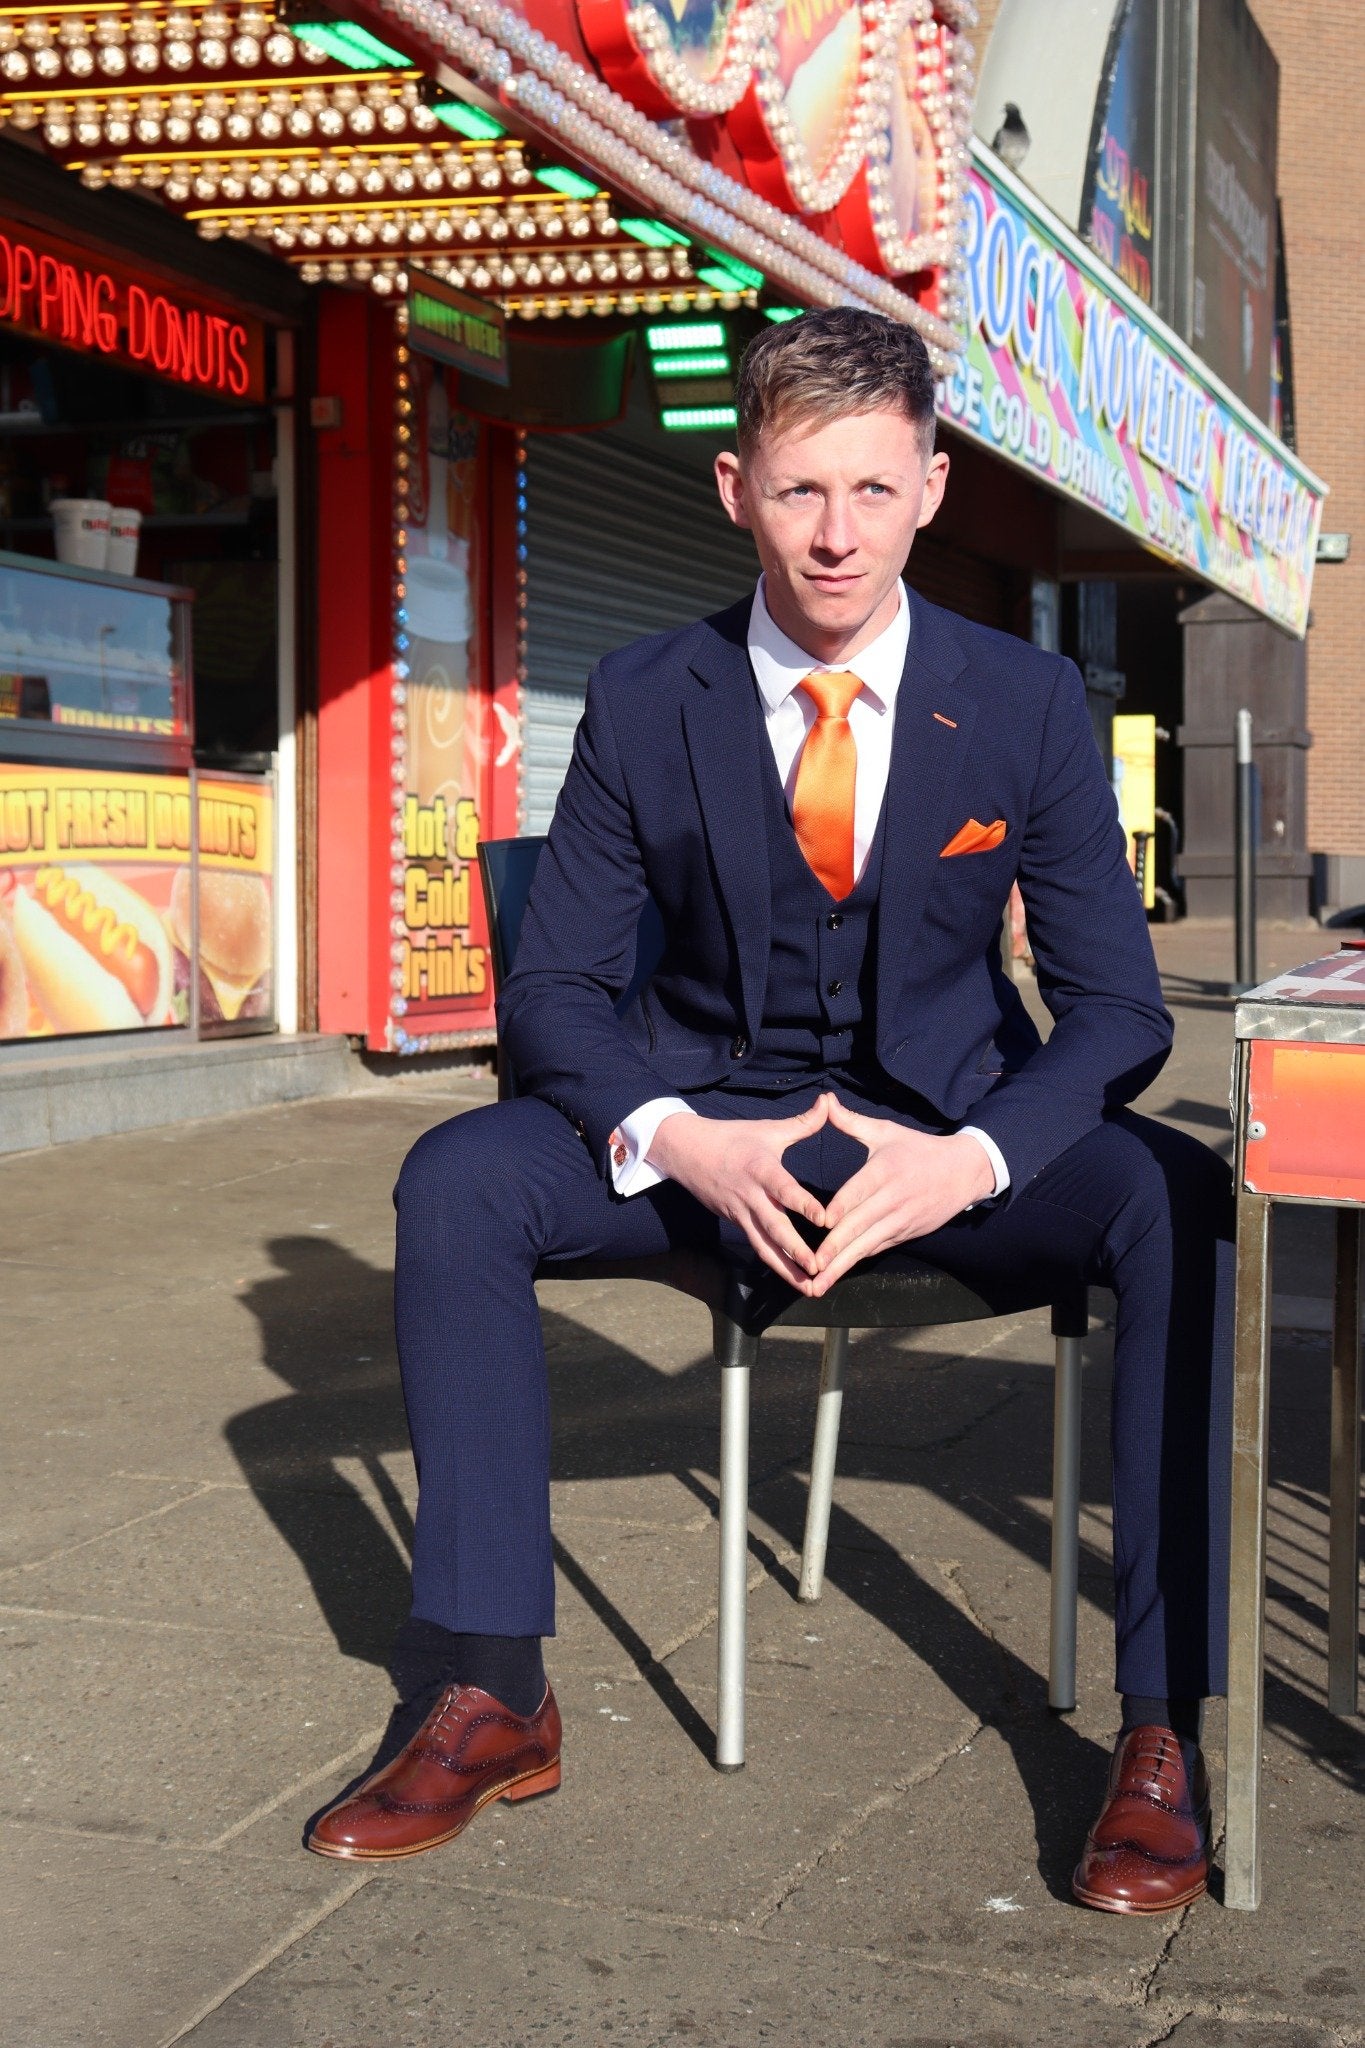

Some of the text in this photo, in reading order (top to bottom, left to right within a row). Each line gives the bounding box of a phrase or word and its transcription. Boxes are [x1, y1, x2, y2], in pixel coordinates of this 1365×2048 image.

[961, 182, 1066, 392] ROCK
[128, 284, 249, 396] DONUTS
[990, 381, 1051, 468] COLD
[1058, 427, 1133, 516] DRINKS
[0, 787, 258, 861] OT FRESH DONUTS
[456, 797, 481, 861] &
[405, 864, 470, 930] Cold
